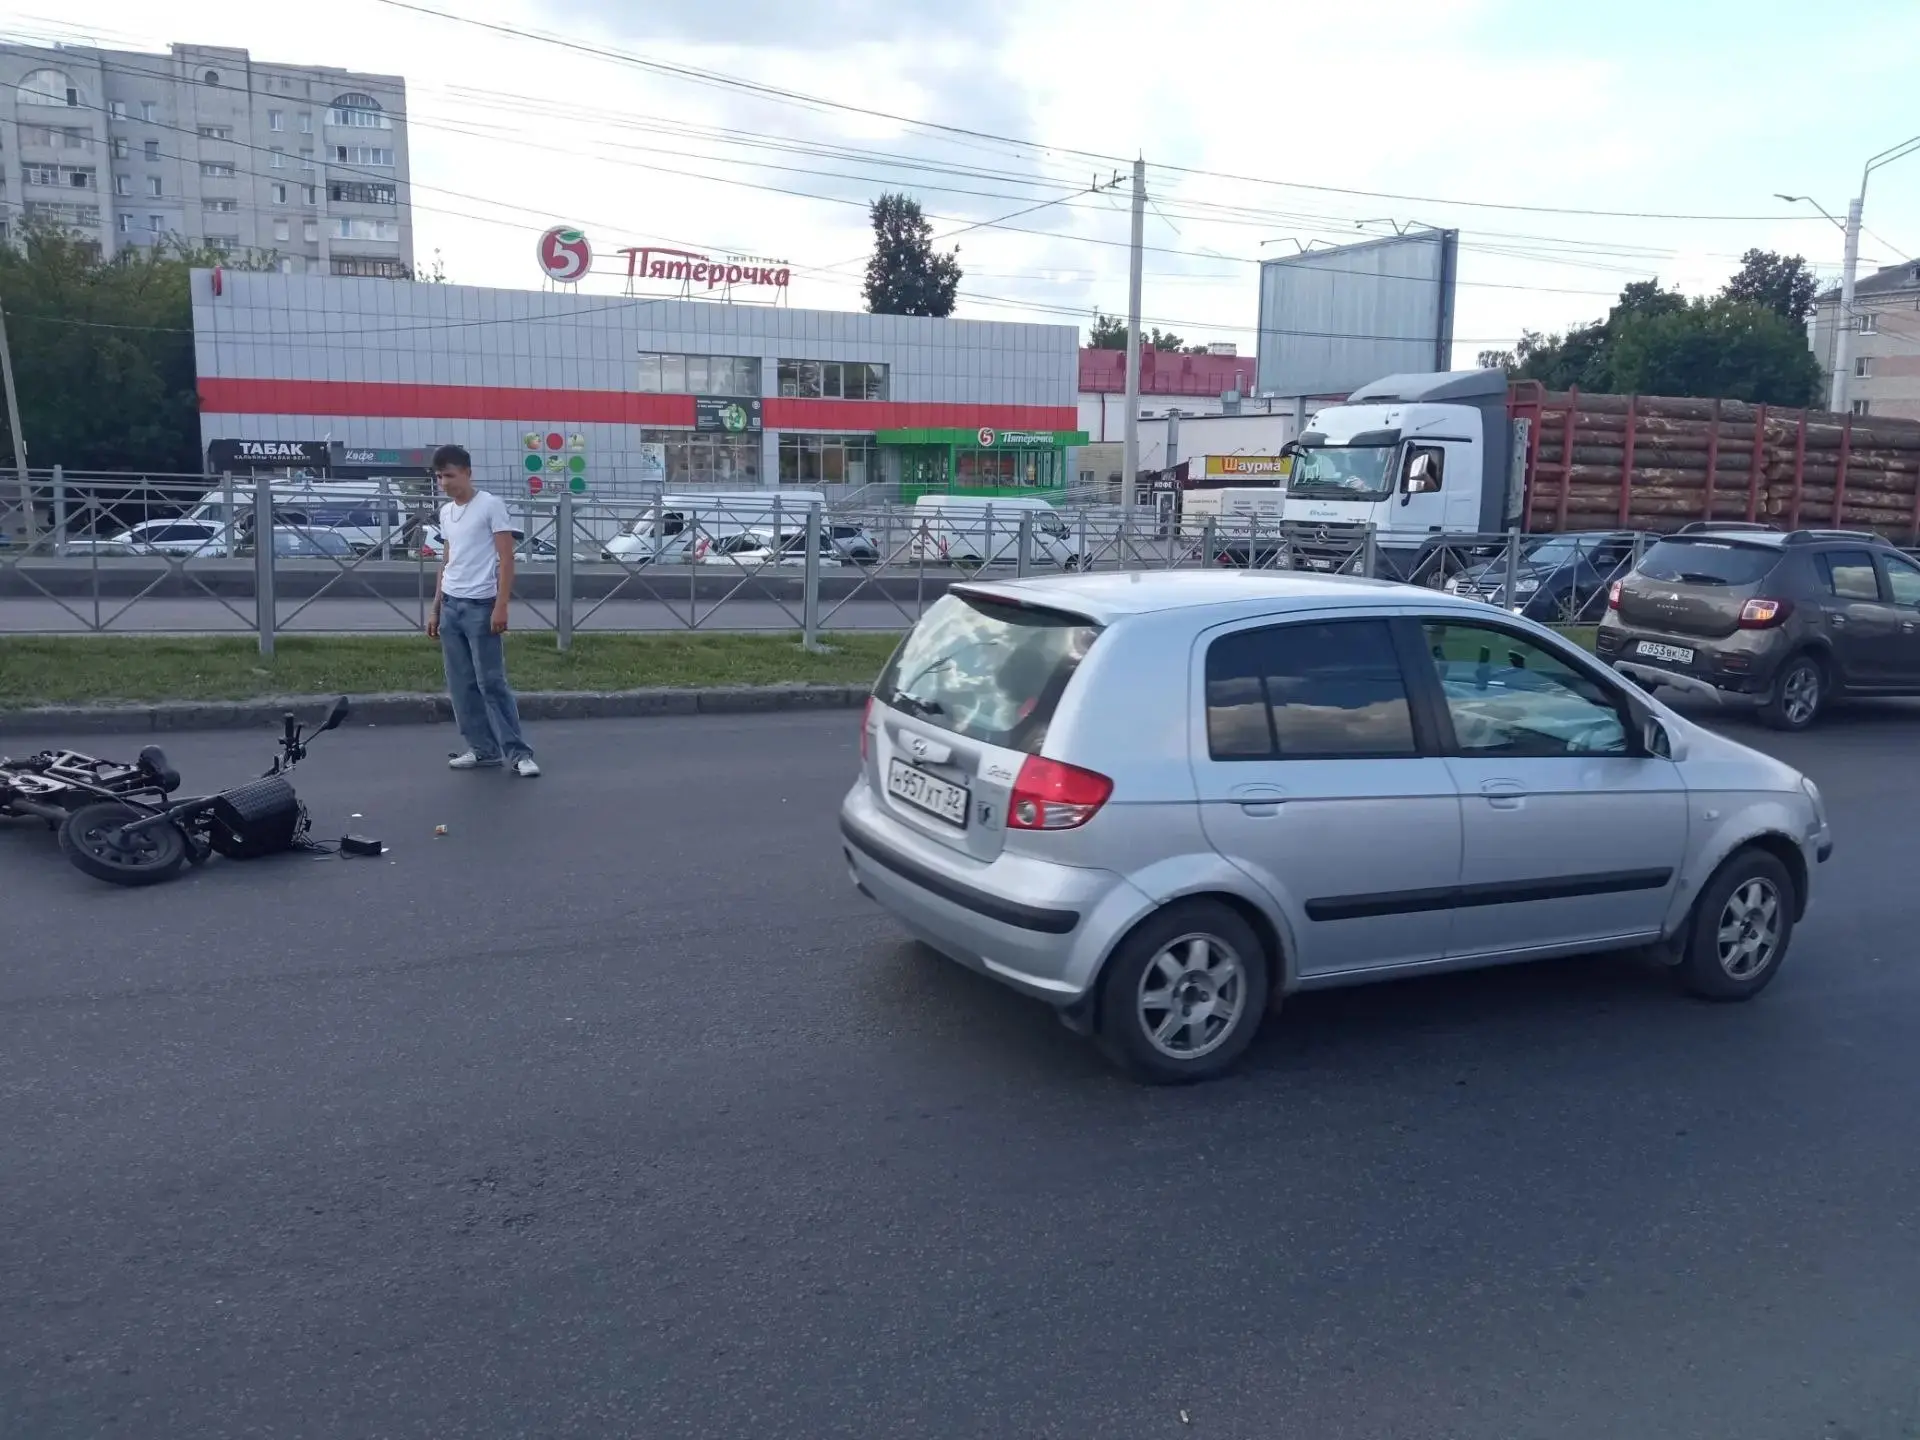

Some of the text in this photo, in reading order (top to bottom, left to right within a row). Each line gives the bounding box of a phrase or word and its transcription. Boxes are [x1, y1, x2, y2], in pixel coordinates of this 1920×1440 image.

[617, 247, 790, 290] Пятёрочка
[239, 442, 304, 455] ТАБАК
[345, 450, 374, 463] Кофе
[1222, 457, 1281, 474] Шаурма
